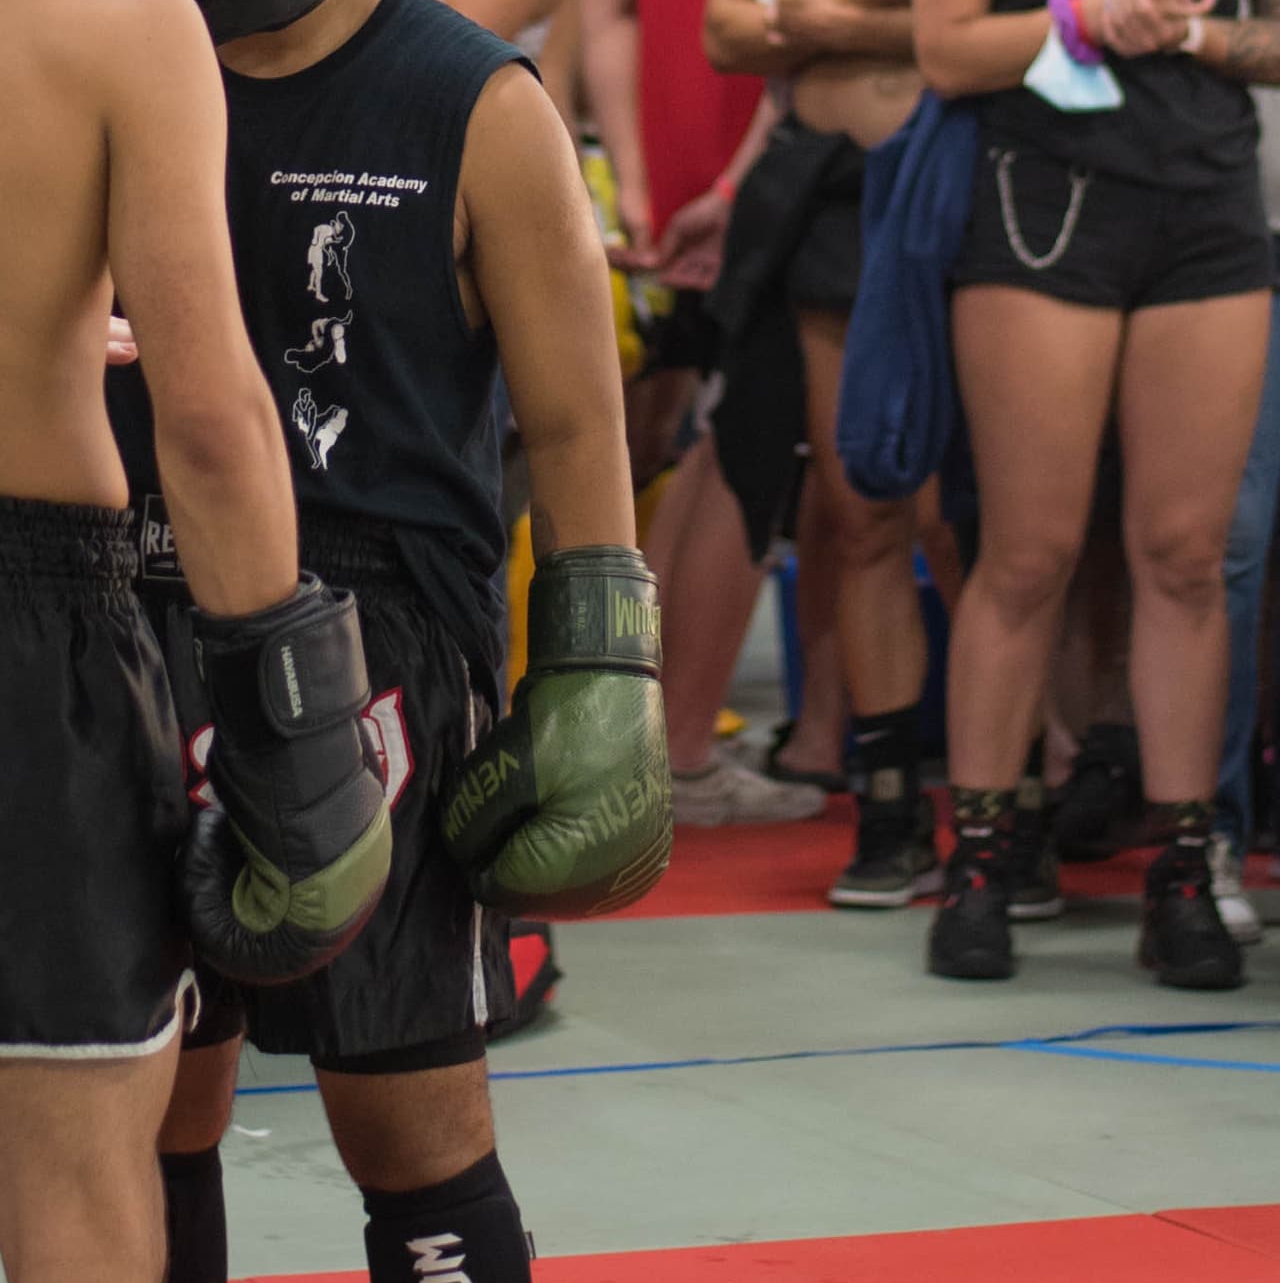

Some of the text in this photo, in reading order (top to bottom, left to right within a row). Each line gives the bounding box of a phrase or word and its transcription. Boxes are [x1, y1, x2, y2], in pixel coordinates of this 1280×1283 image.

[270, 169, 428, 194] Concepcion Academy
[290, 188, 401, 208] of Martial Arts
